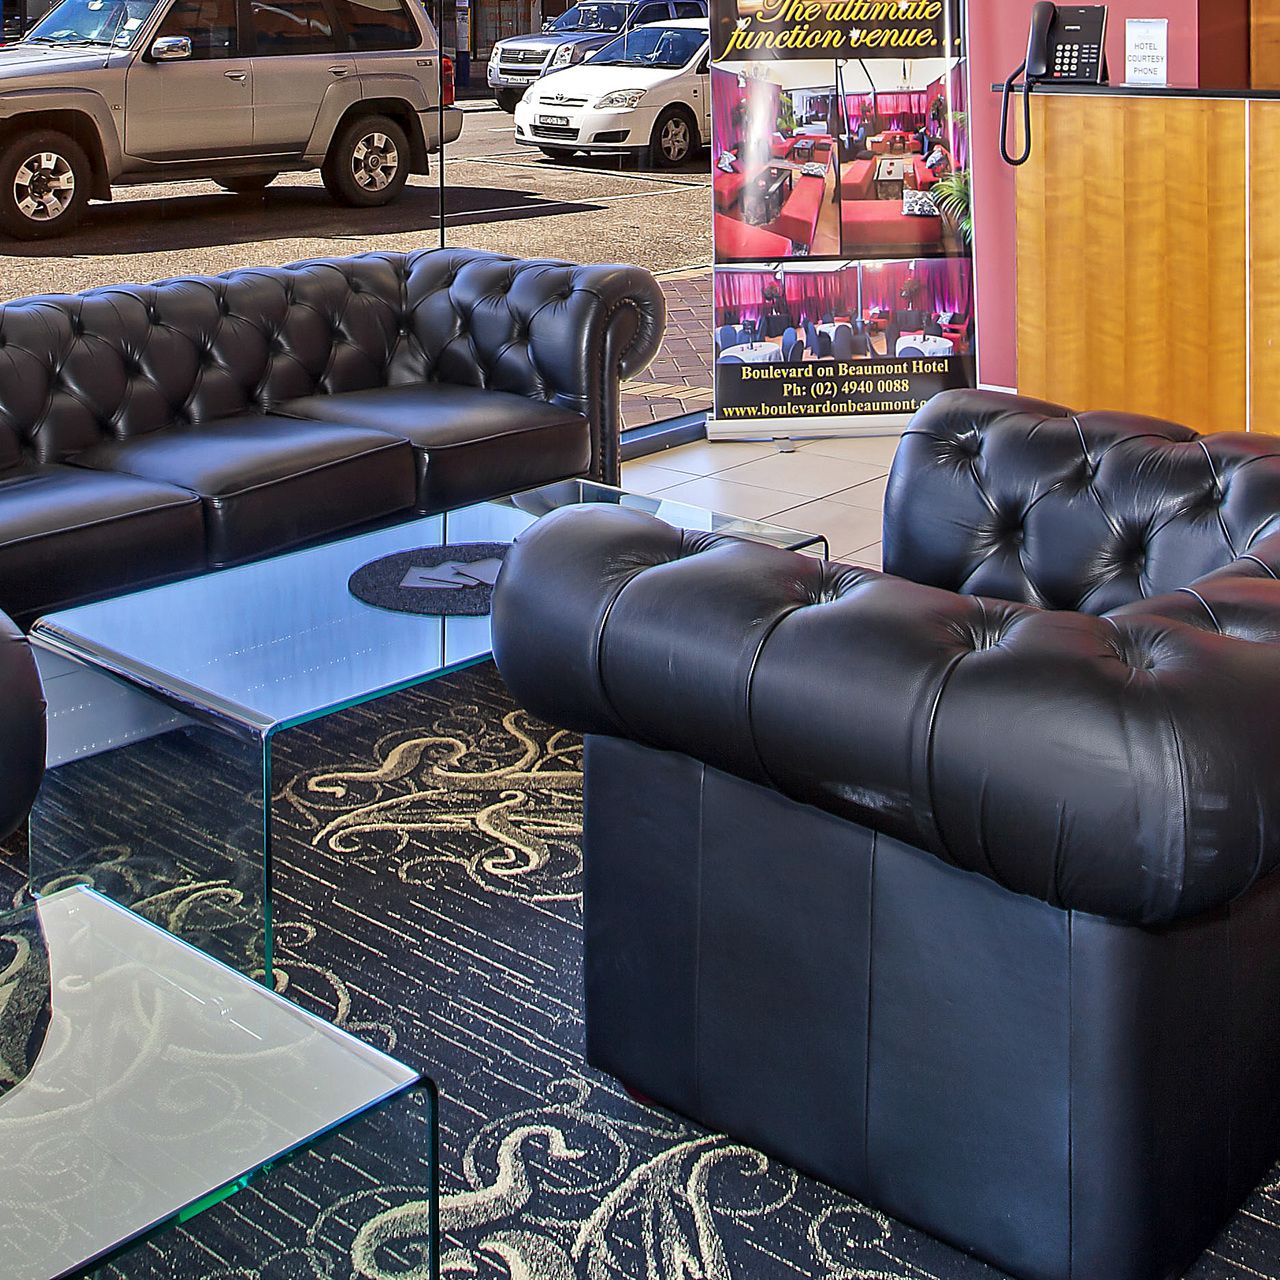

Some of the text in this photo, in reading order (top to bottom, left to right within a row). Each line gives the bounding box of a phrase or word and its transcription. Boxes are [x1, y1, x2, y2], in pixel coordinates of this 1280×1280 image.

[712, 16, 847, 63] function
[1134, 42, 1158, 51] HOTEL
[1127, 54, 1165, 63] COURTESY
[1133, 67, 1158, 76] PHONE
[741, 359, 949, 380] Boulevard on Beaumont Hotel
[783, 378, 909, 399] Ph: (02) 4940 0088
